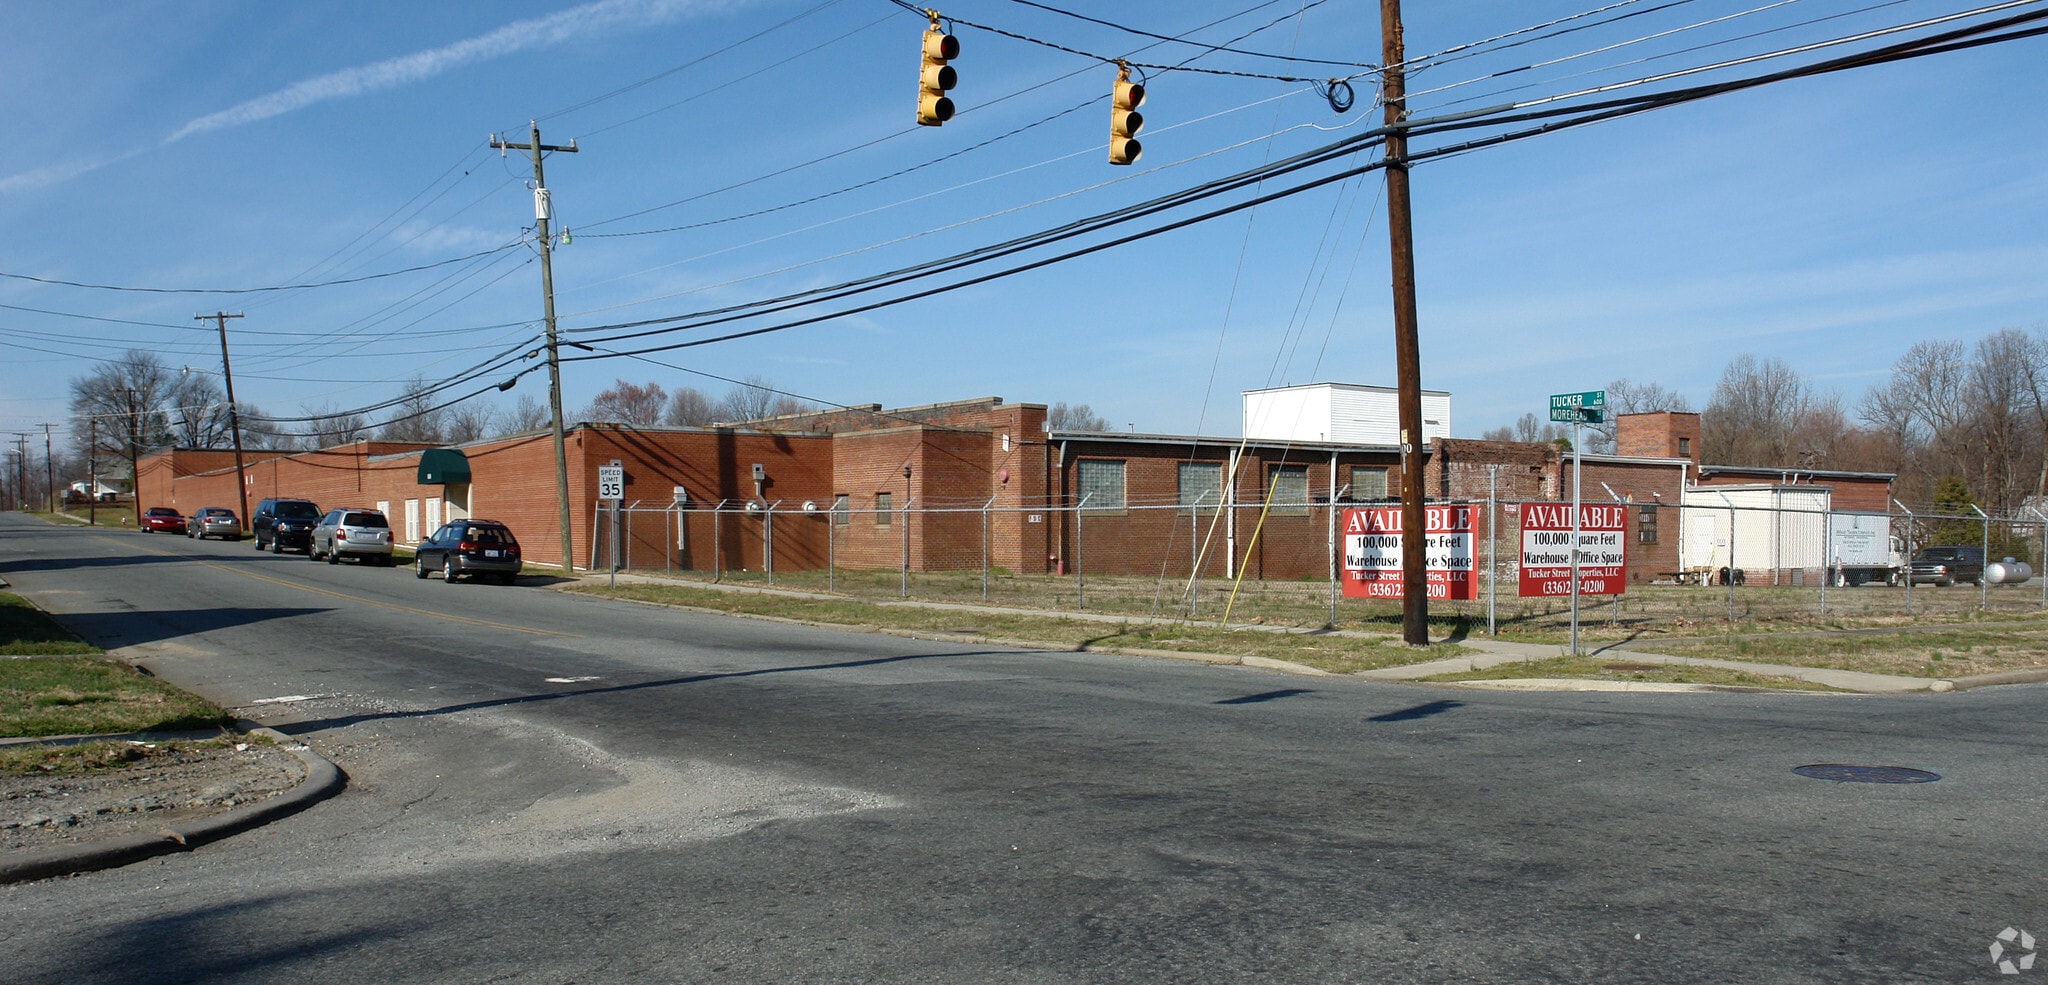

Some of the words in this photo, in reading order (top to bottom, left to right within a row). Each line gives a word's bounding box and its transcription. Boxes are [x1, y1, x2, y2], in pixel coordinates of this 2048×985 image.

[1552, 395, 1583, 407] TUCKER
[1551, 409, 1588, 420] MOREHEAD
[602, 484, 620, 496] 35
[1347, 508, 1472, 532] AVAILBLE
[1357, 536, 1397, 550] 100,000
[1439, 535, 1461, 548] Feet
[1534, 532, 1569, 546] 100,000
[1600, 533, 1616, 545] Feet
[1347, 555, 1397, 567] Warehouse
[1440, 554, 1472, 569] Space
[1524, 552, 1569, 564] Warehouse
[1601, 551, 1622, 565] Space
[1351, 571, 1376, 581] Tucker
[1378, 571, 1400, 580] Street
[1446, 571, 1466, 581] LLC
[1528, 569, 1550, 578] Tucker
[1552, 569, 1570, 578] Street
[1605, 567, 1619, 577] LLC
